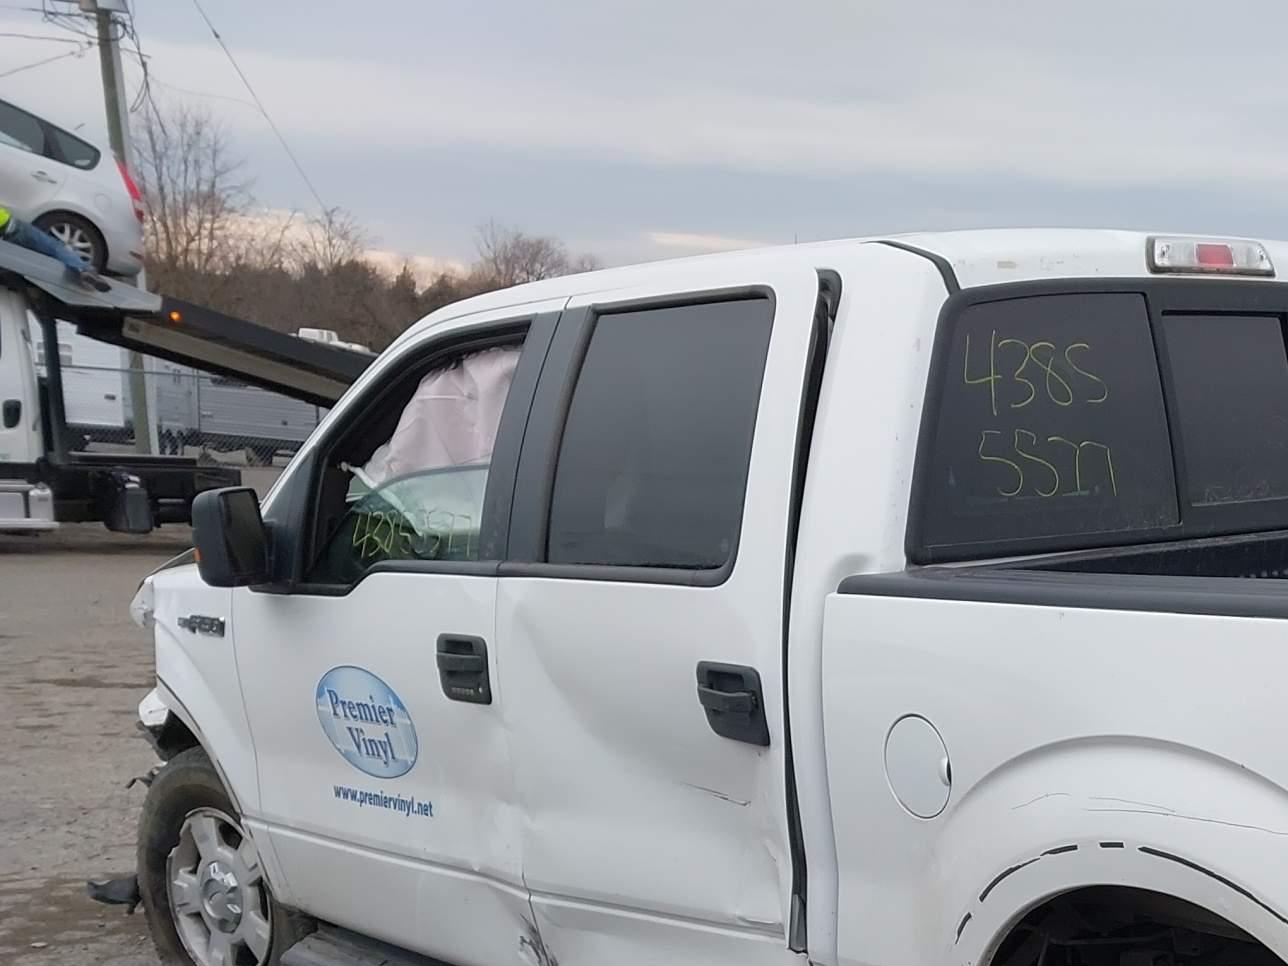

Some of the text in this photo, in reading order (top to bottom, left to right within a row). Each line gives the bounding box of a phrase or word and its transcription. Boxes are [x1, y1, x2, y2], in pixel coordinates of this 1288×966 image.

[327, 689, 396, 729] Premier
[347, 726, 397, 769] Vinyl
[333, 784, 434, 818] www.premiervinyl.net
